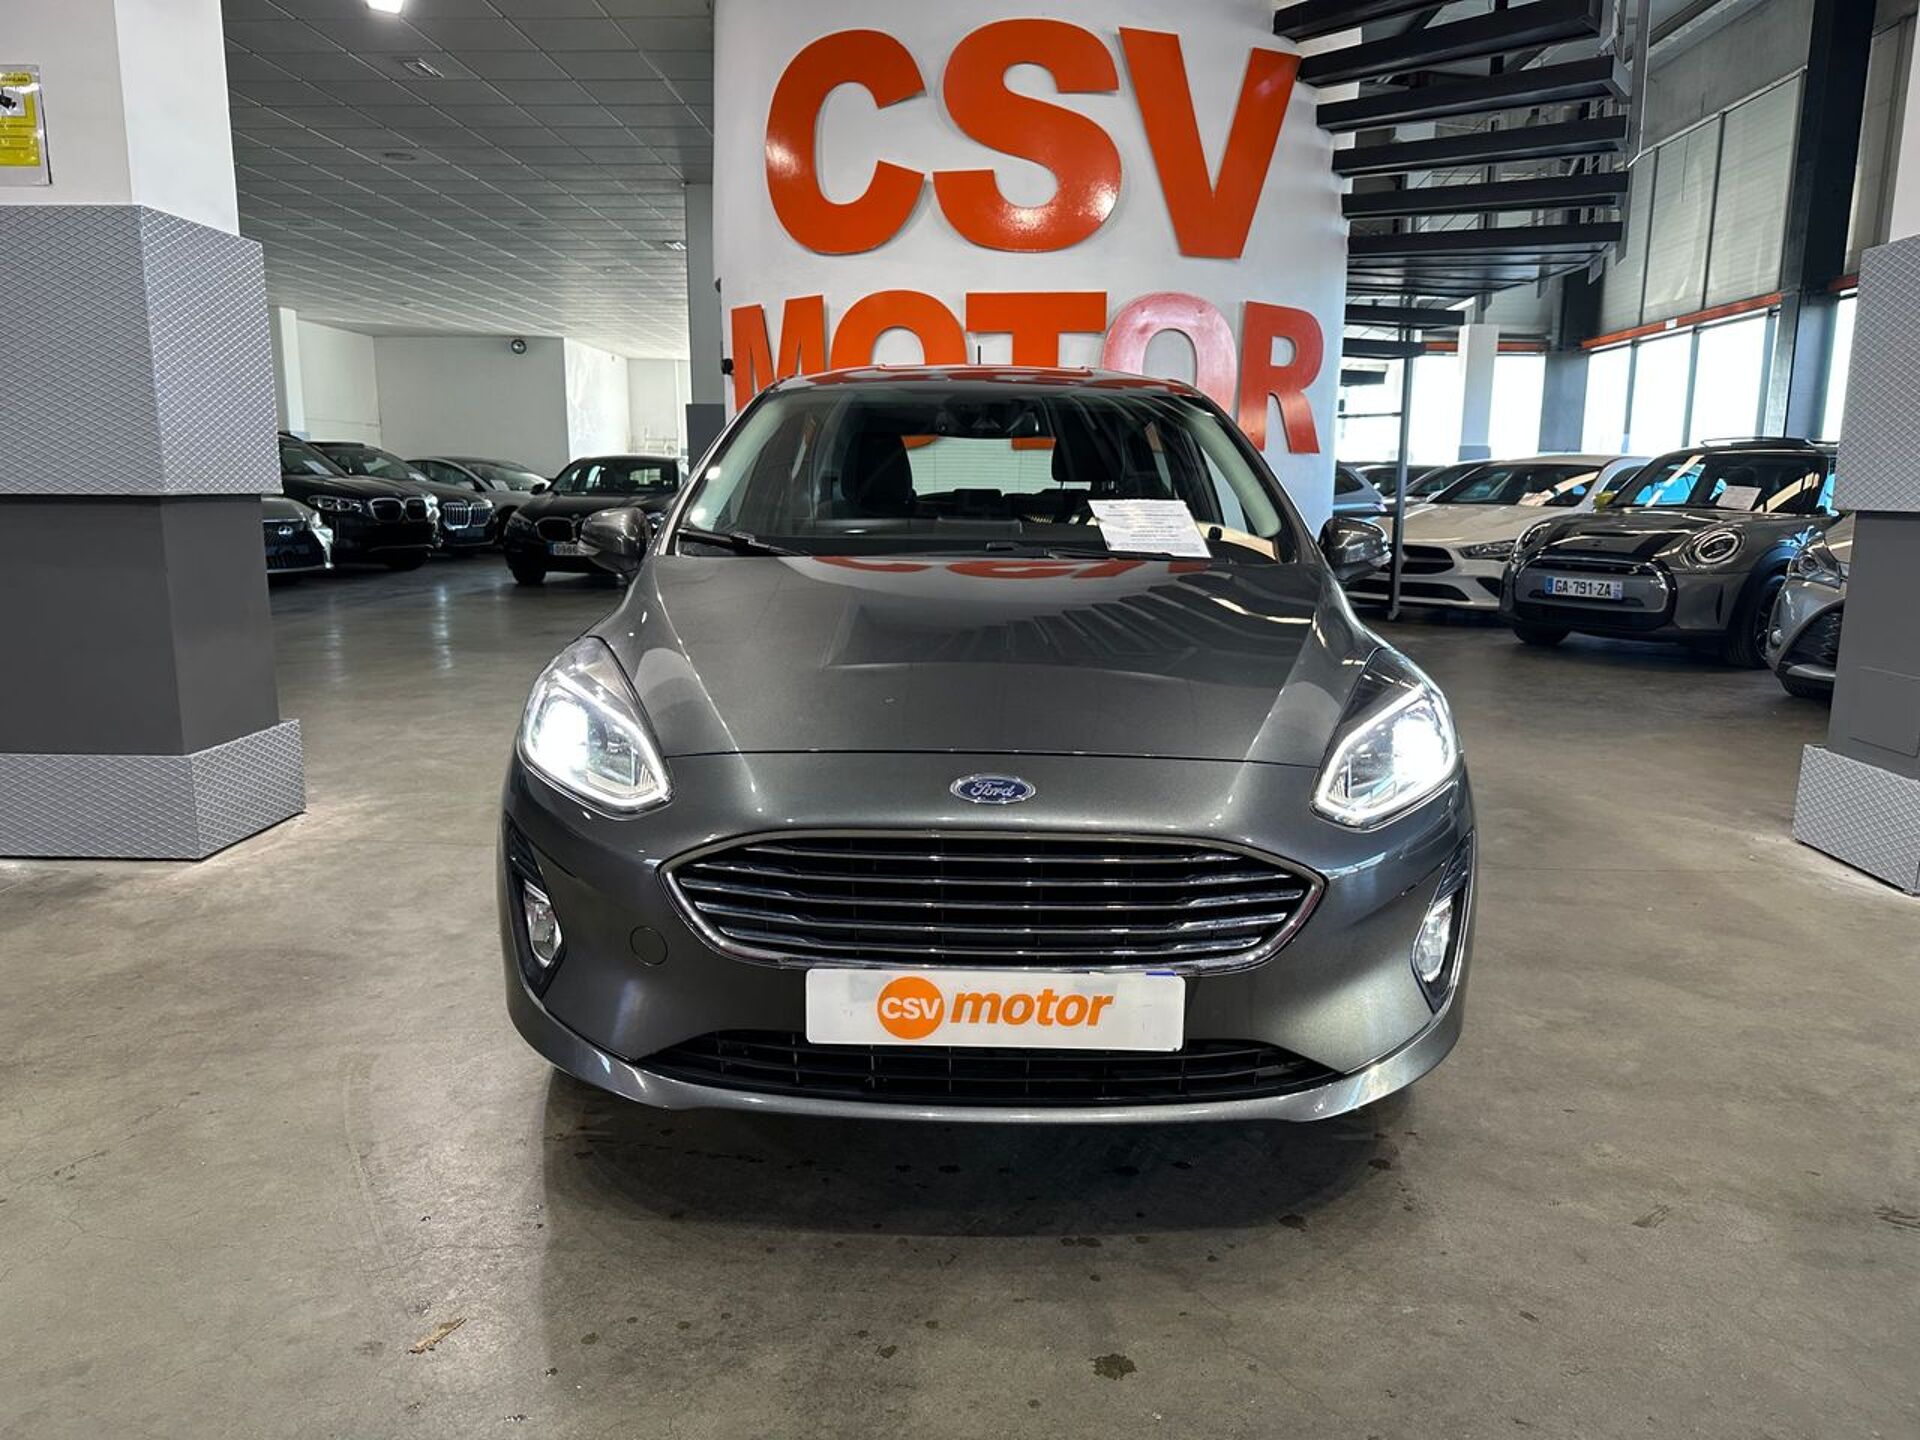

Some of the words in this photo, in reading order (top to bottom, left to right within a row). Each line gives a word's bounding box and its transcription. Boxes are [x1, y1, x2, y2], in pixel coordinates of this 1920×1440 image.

[765, 18, 1302, 259] CSV
[731, 289, 1323, 454] MOTOR
[1555, 580, 1611, 597] GA-791-ZA
[970, 781, 1016, 797] Ford
[881, 997, 940, 1020] CSV
[950, 989, 1114, 1026] motor
